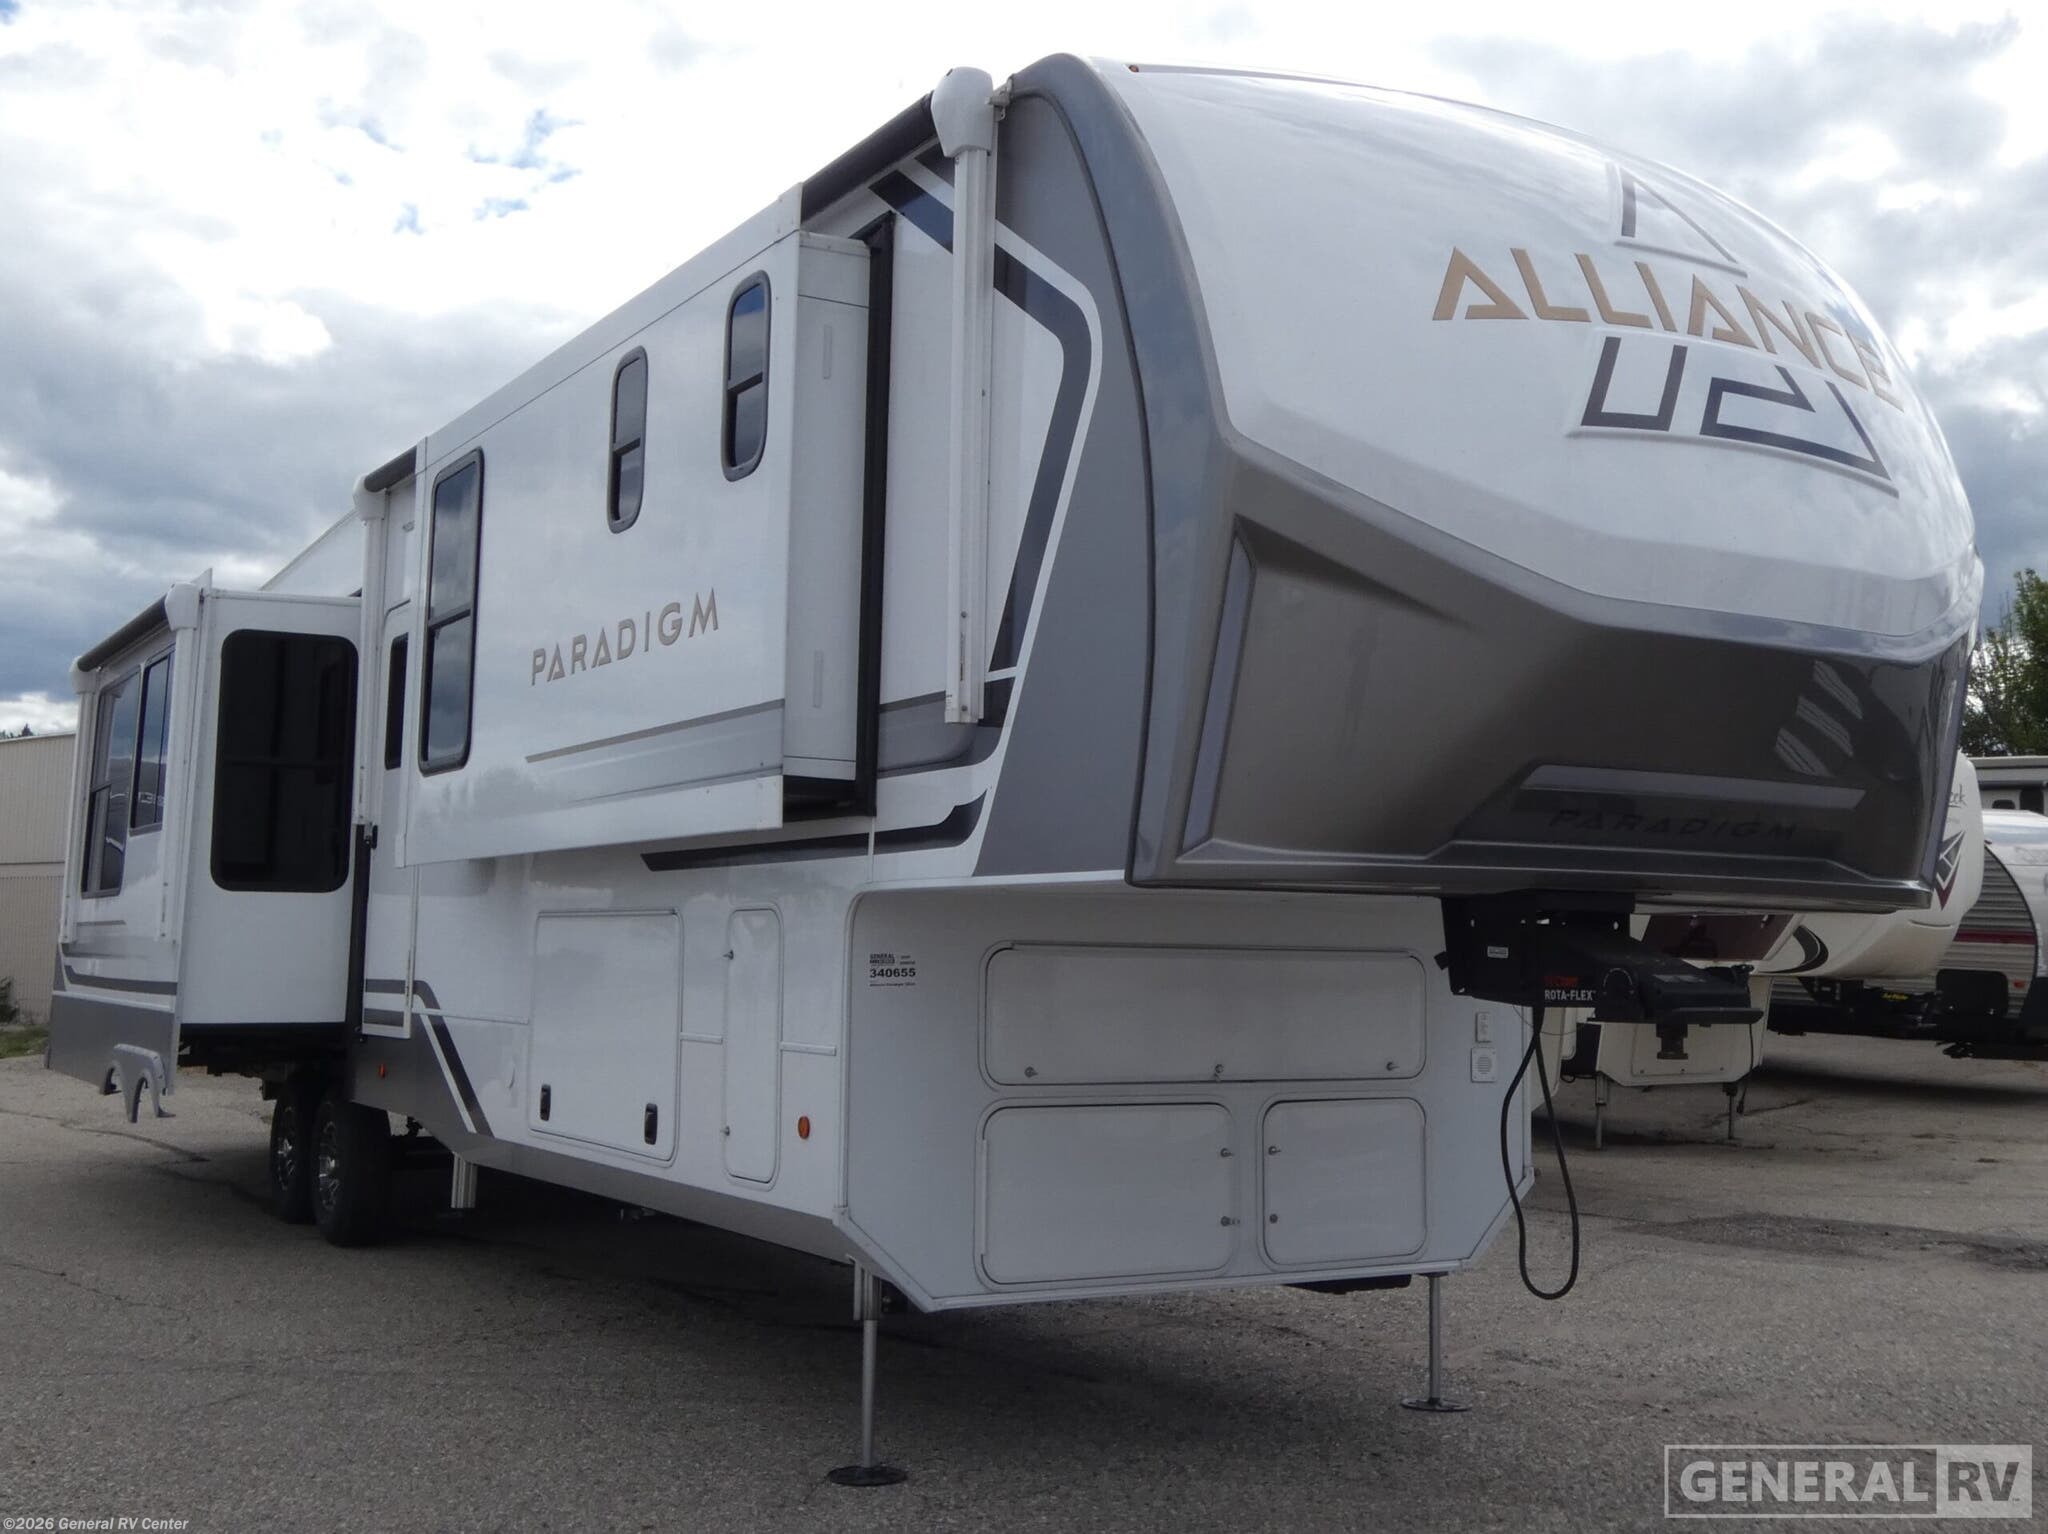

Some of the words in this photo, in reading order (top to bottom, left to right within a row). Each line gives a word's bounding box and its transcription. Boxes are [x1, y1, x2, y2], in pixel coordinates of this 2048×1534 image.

[1432, 246, 1905, 412] ALLIANCE
[531, 587, 719, 687] PARADIGM
[1548, 807, 1798, 842] PARADIGM
[869, 967, 916, 979] 340655
